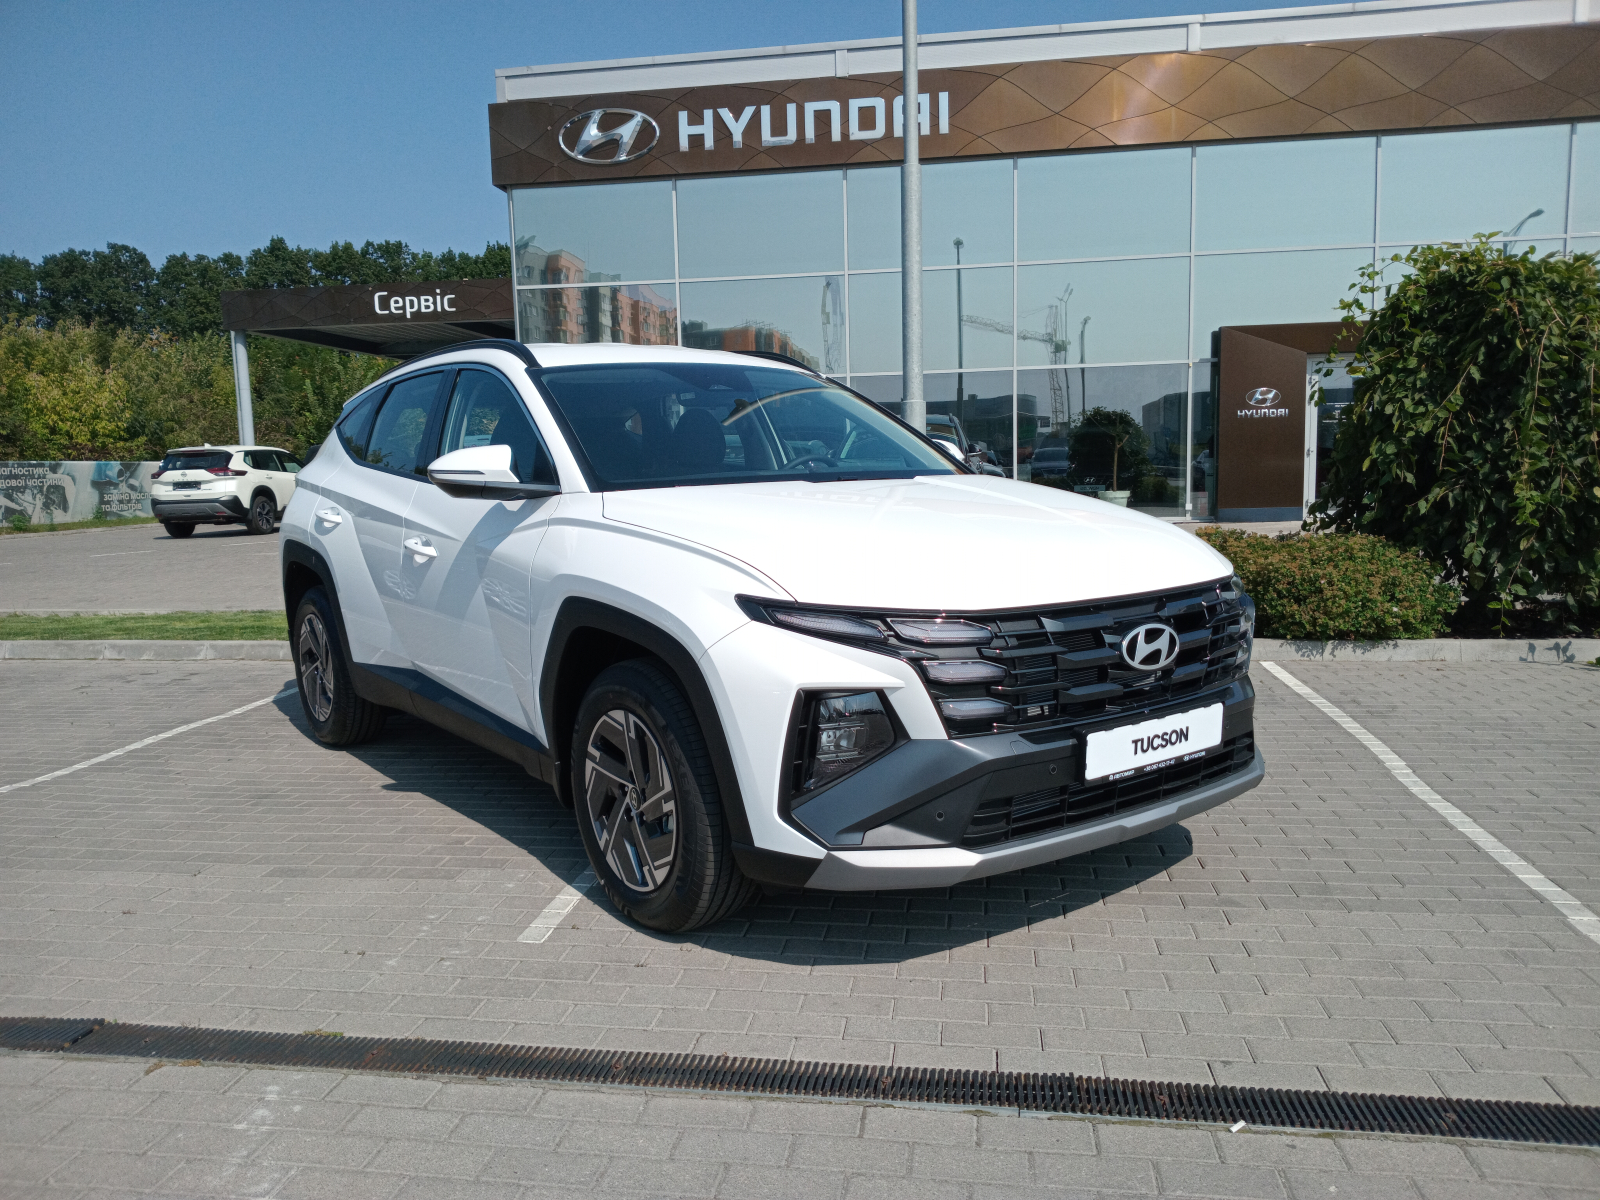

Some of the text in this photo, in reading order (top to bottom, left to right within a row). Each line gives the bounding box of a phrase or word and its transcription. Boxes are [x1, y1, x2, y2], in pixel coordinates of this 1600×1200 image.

[678, 91, 949, 152] HYUNDAI
[373, 288, 457, 319] Сервіс
[1237, 408, 1289, 418] HYUNDAI
[0, 464, 50, 475] агностика
[1131, 726, 1190, 756] TUCSON
